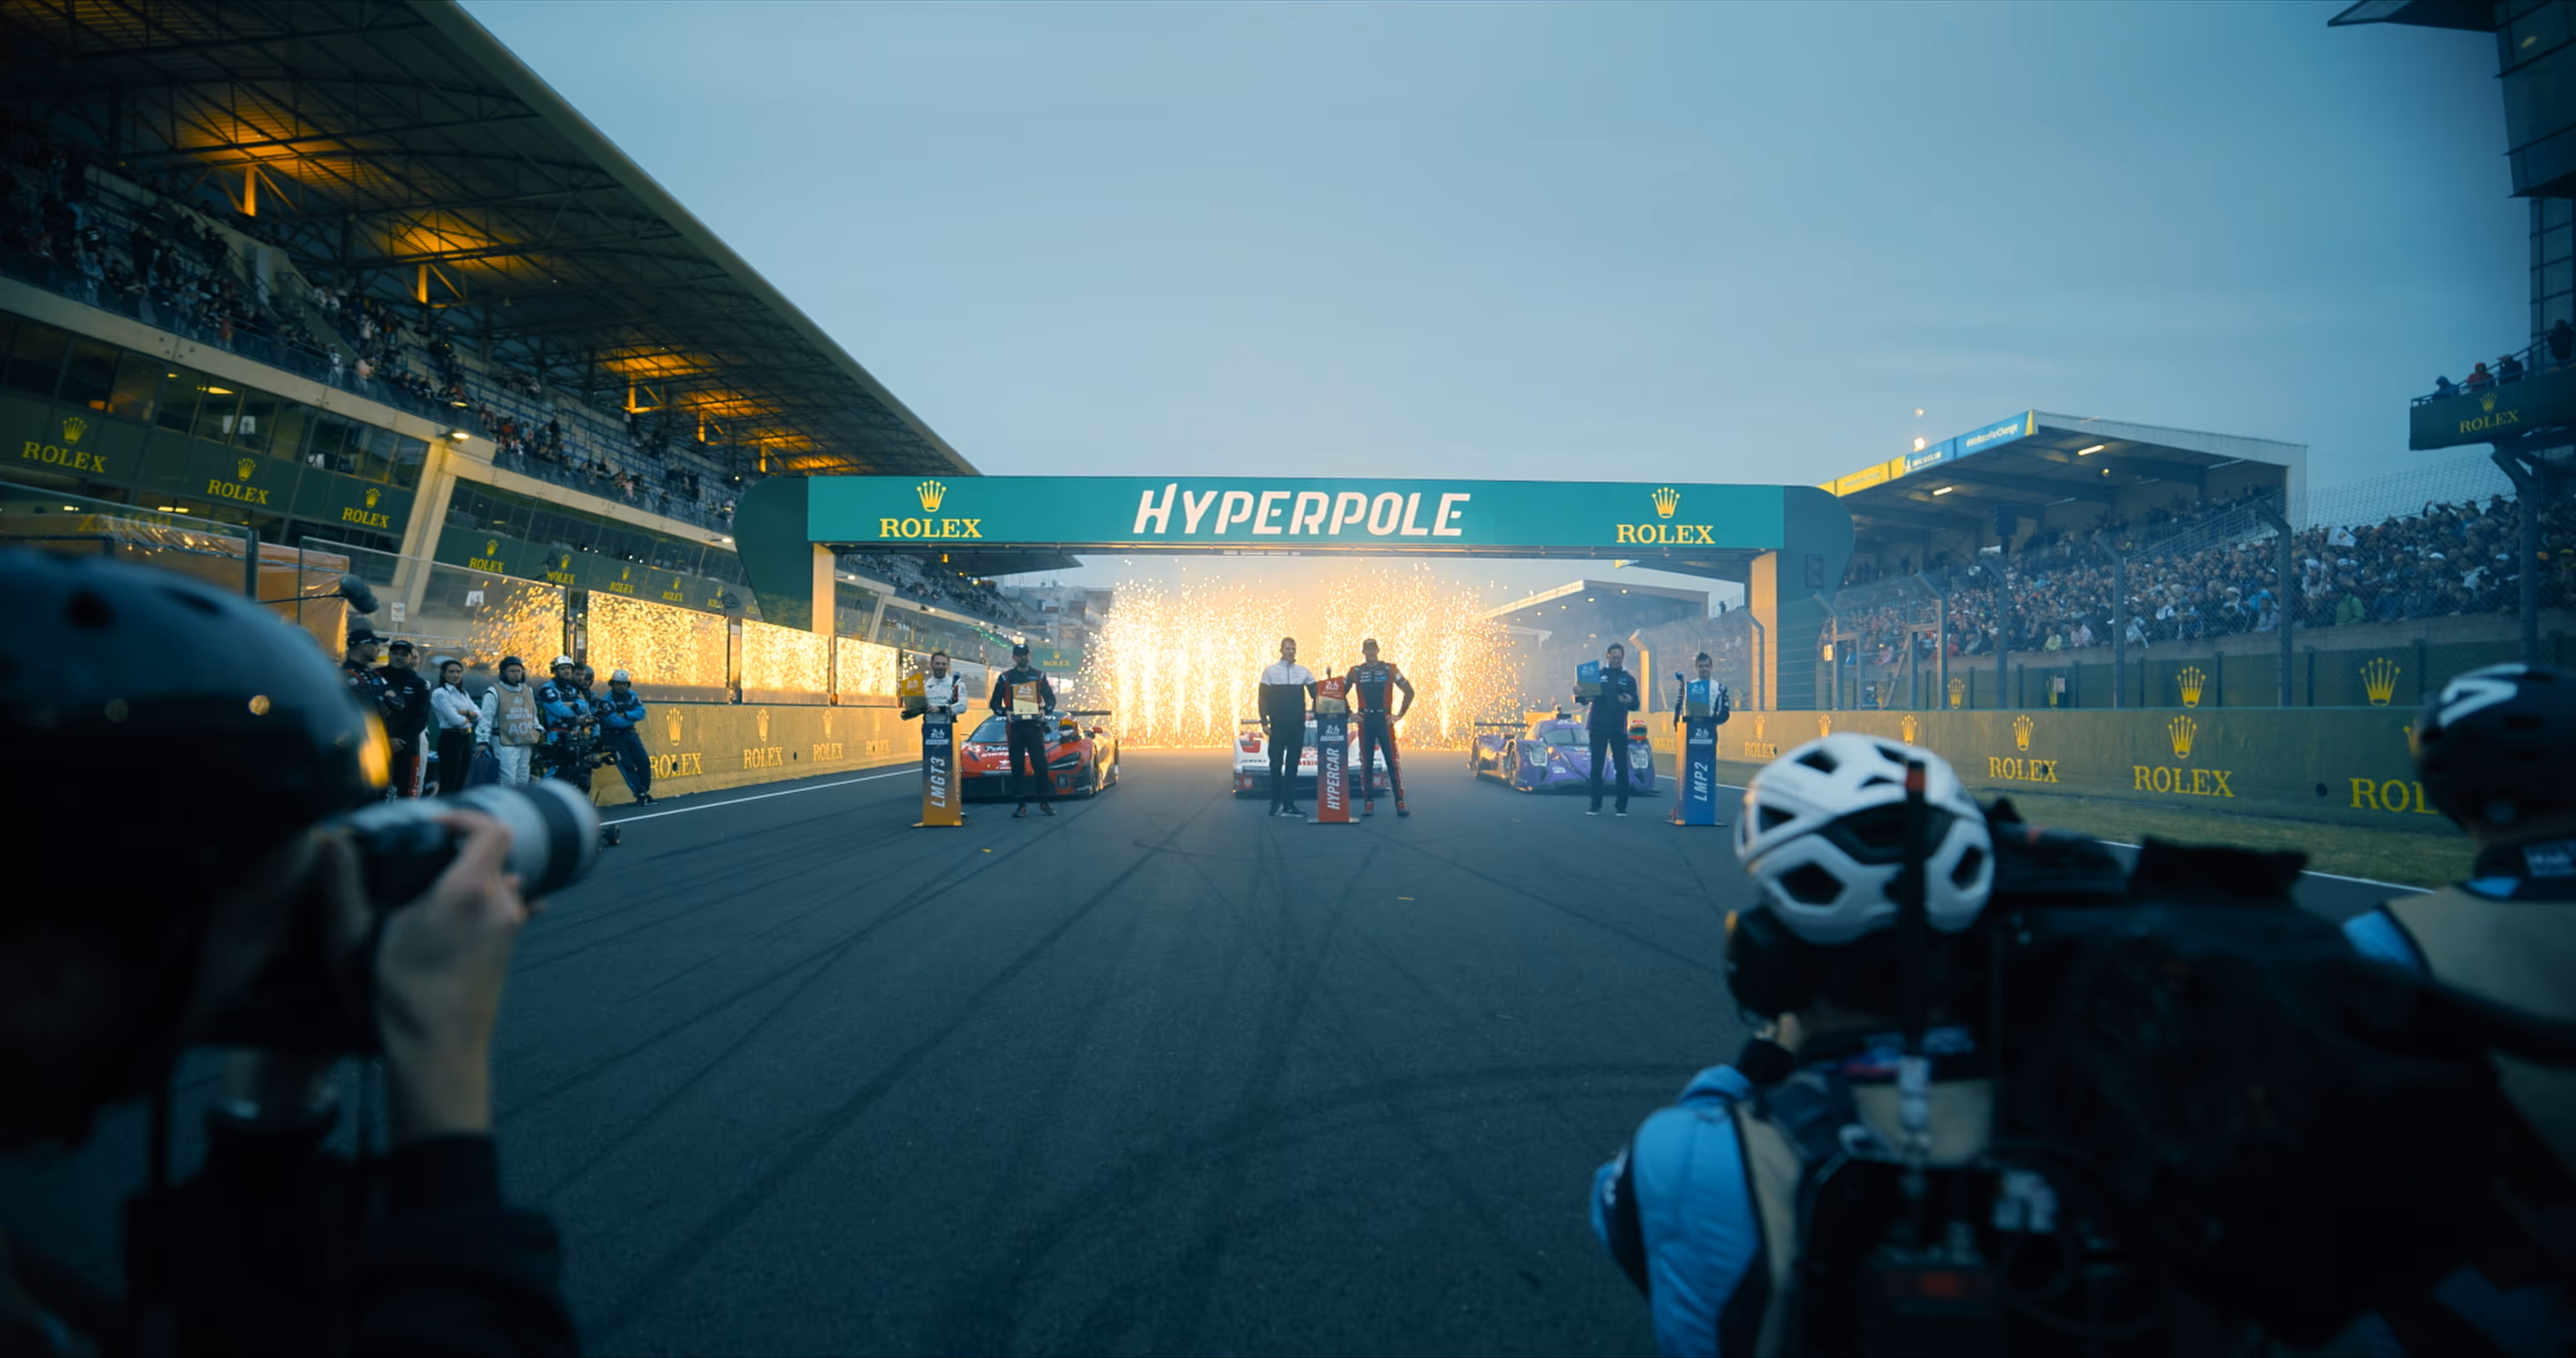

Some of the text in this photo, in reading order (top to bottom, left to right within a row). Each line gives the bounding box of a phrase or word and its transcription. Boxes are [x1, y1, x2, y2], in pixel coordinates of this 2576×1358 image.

[2460, 410, 2518, 434] ROLEX
[21, 441, 107, 473] ROLEX
[207, 479, 269, 504] ROLEX
[341, 507, 389, 528] ROLEX
[1133, 483, 1471, 536] HYPERPOLE
[879, 518, 982, 538] ROLEX
[1616, 524, 1716, 544] ROLEX
[469, 557, 504, 573] ROLEX
[743, 747, 783, 770] ROLEX
[813, 742, 843, 761] ROLEX
[1745, 742, 1777, 759] ROLEX
[650, 753, 702, 778] ROLEX
[1989, 756, 2059, 783] ROLEX
[931, 756, 946, 808] LMGT3
[1327, 748, 1340, 810] HYPERCAR
[1694, 762, 1708, 802] LMP2
[2133, 765, 2235, 797] ROLEX
[2348, 777, 2439, 814] ROL
